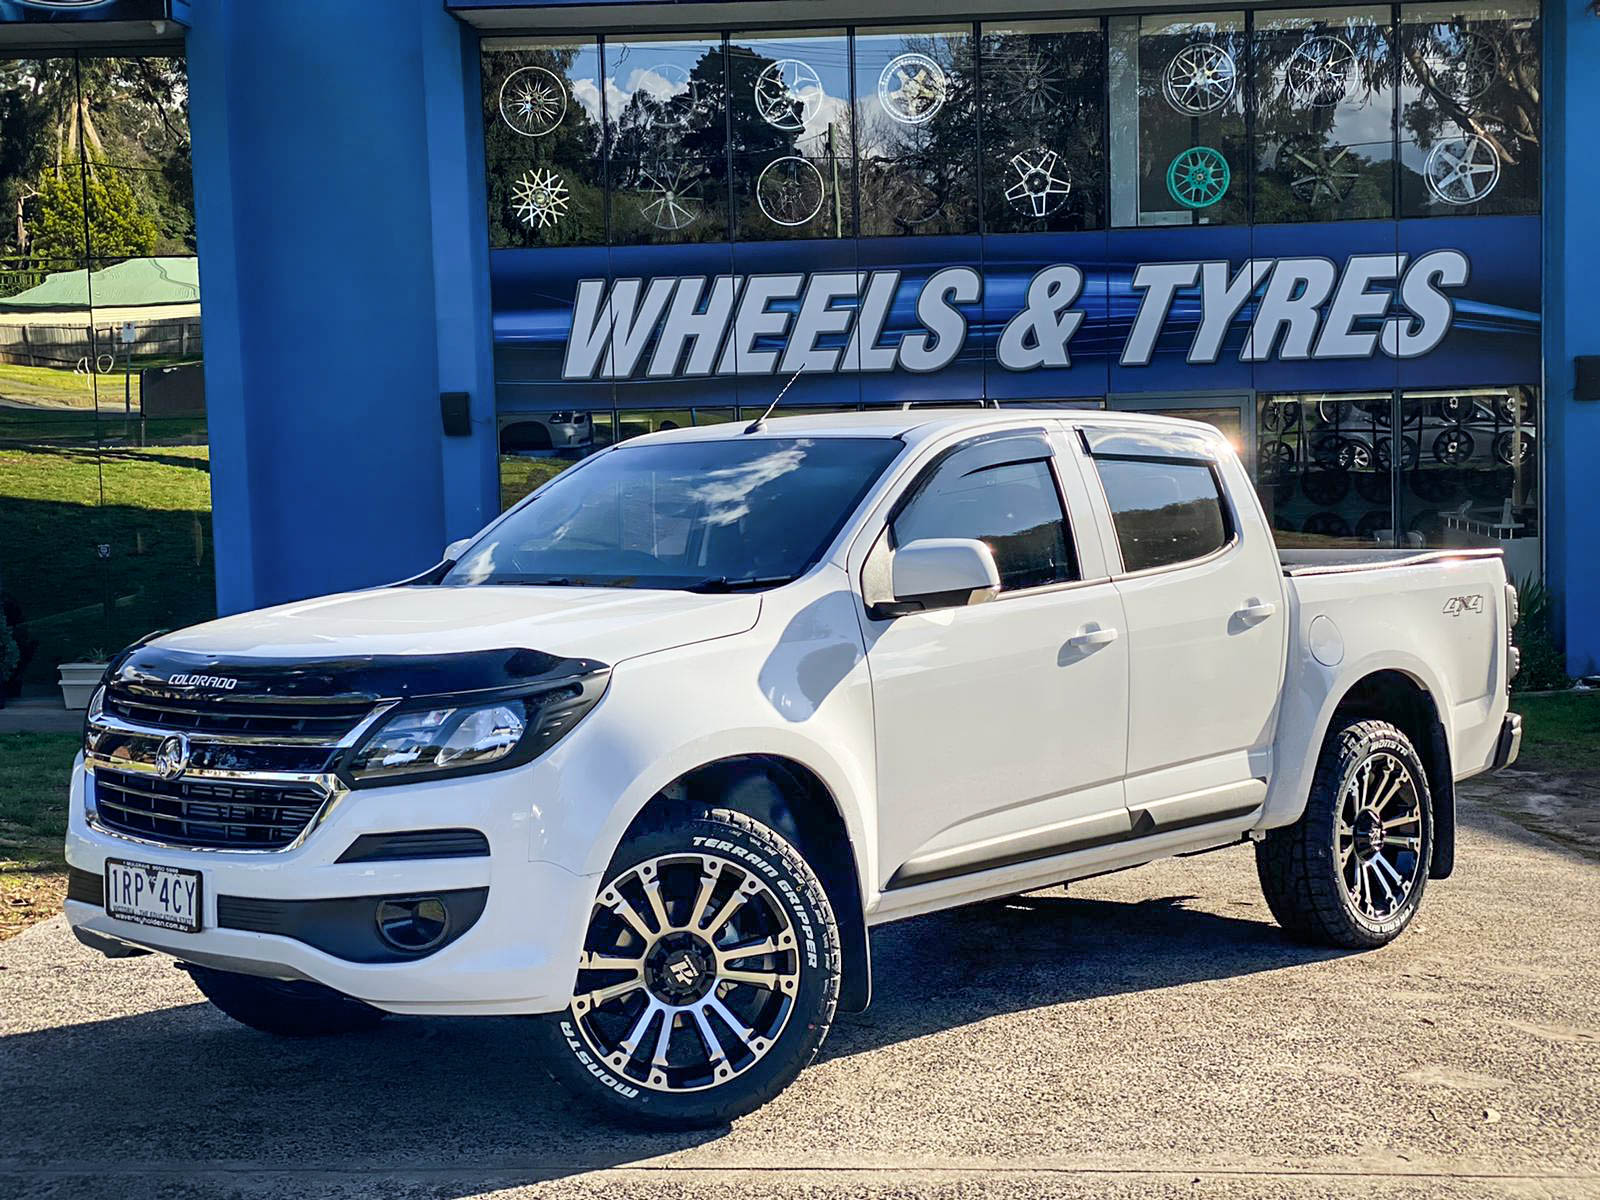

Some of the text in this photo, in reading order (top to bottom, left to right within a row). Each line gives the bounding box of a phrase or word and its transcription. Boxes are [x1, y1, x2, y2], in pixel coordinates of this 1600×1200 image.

[562, 248, 1471, 379] WHEELS & TYRES
[168, 674, 238, 690] COLORADO
[693, 836, 818, 969] TERRAIN GRIPPER
